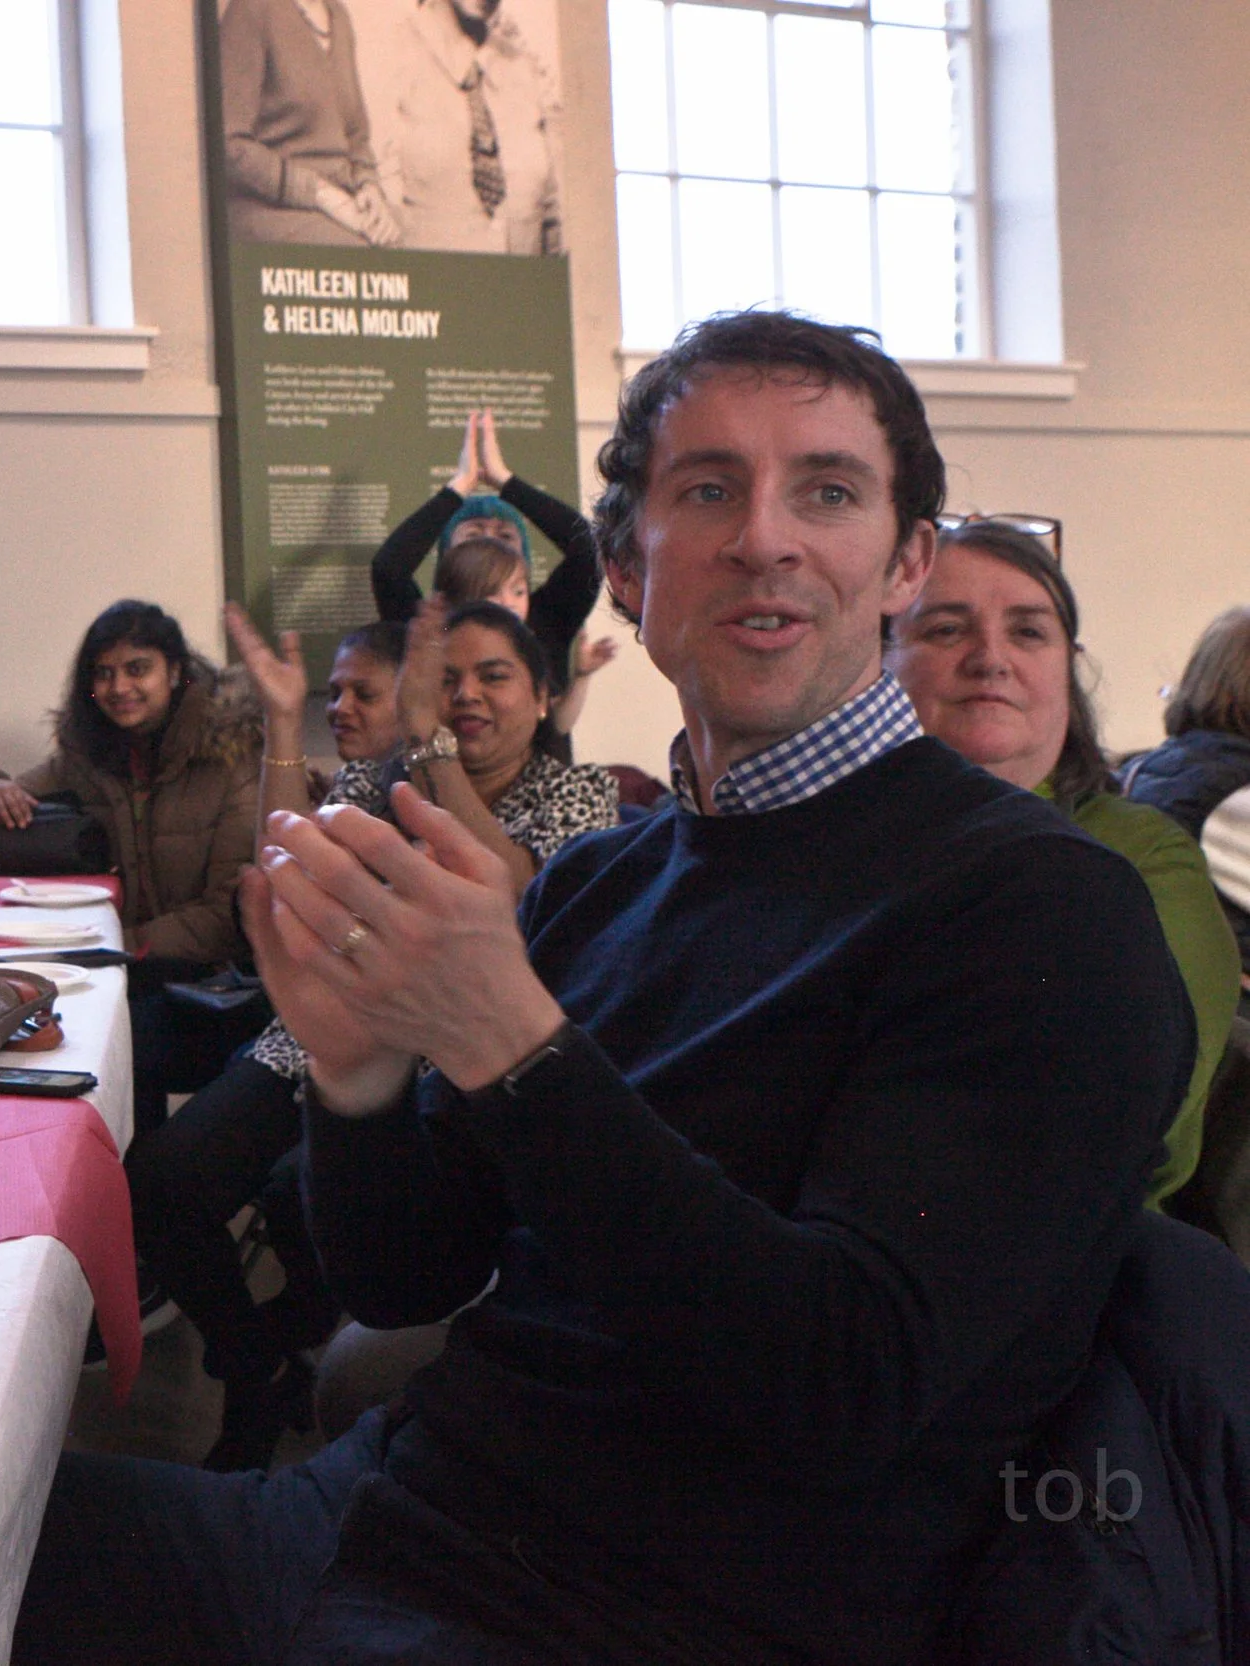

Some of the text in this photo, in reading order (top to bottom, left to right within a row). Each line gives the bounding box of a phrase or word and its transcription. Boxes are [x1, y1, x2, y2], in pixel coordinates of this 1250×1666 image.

[260, 267, 410, 301] KATHLEEN LYNN
[263, 304, 440, 338] & HELENA MOLONY
